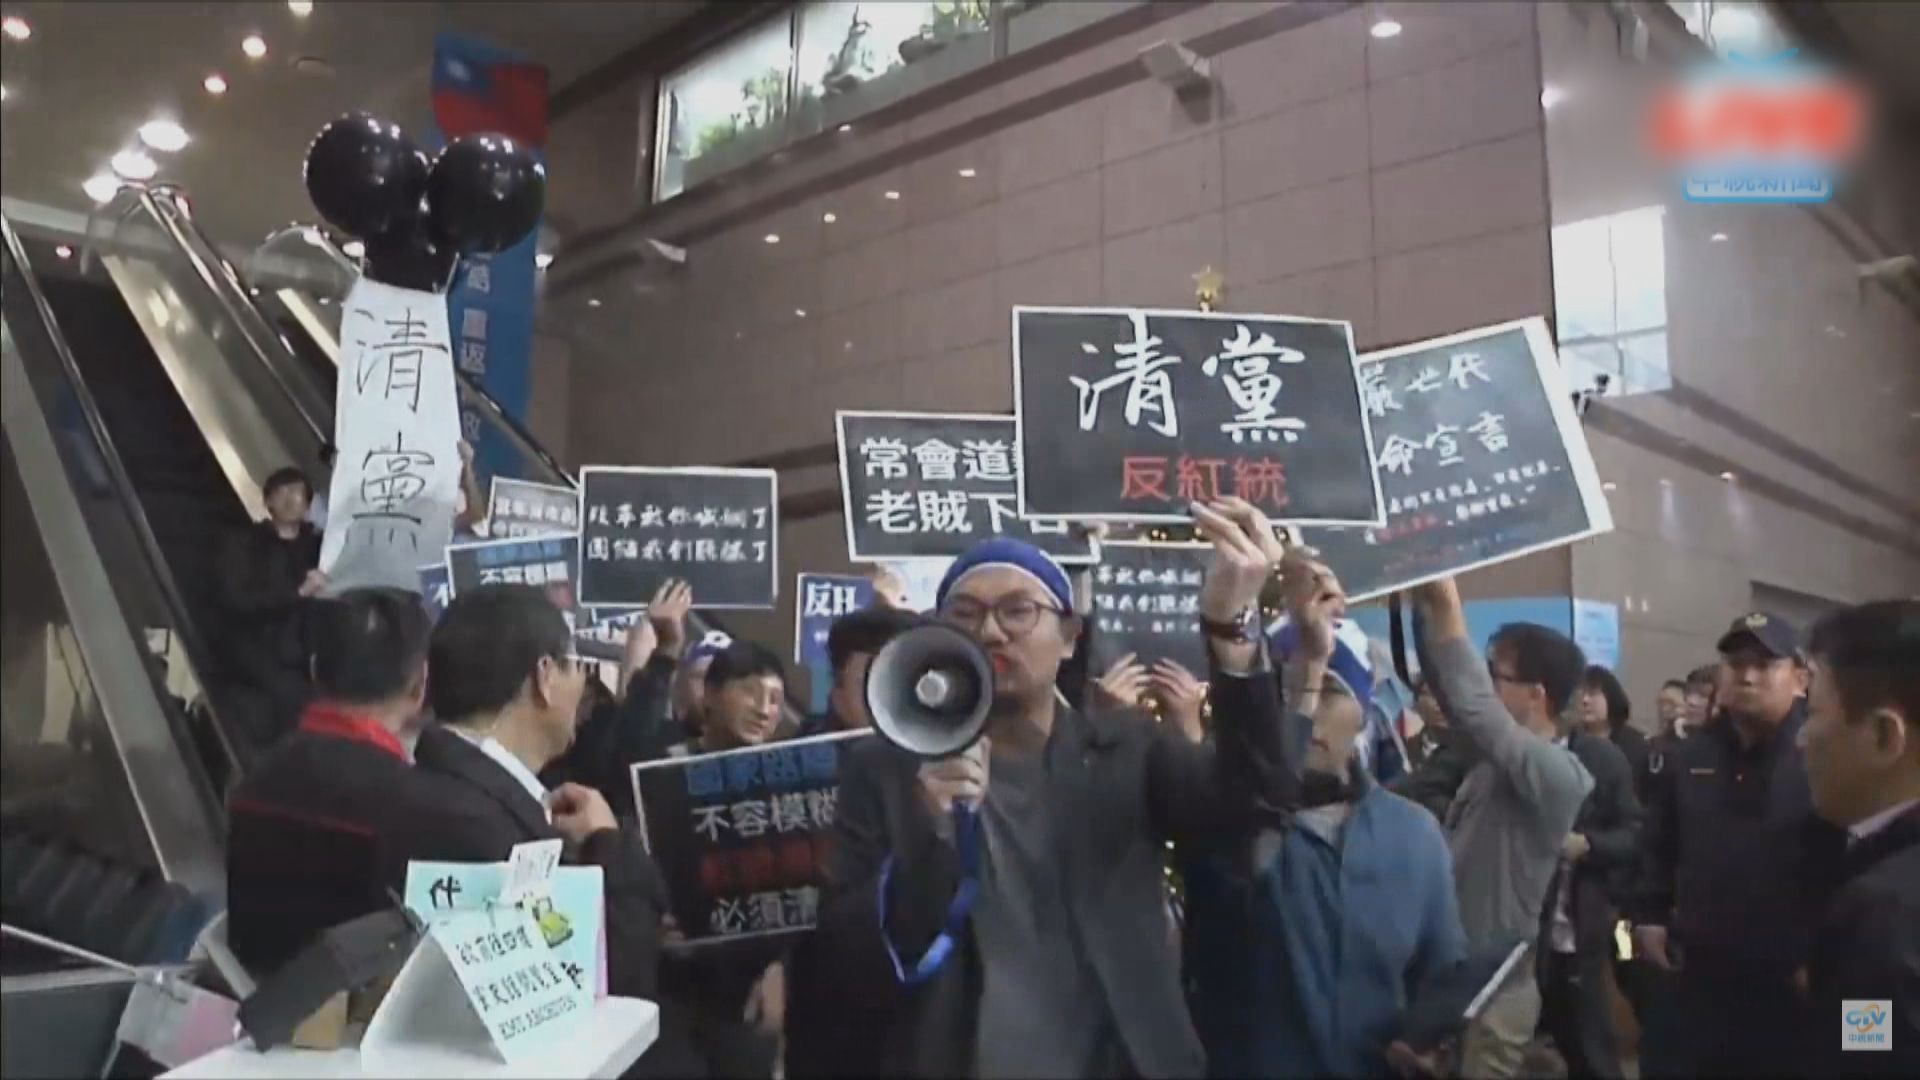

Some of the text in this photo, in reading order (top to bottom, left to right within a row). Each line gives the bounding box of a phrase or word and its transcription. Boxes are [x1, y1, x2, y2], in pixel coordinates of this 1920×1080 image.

[1069, 311, 1307, 443] 清黨
[352, 307, 450, 551] 清黨
[859, 436, 1018, 481] 常會道
[1120, 456, 1291, 508] 反紅統
